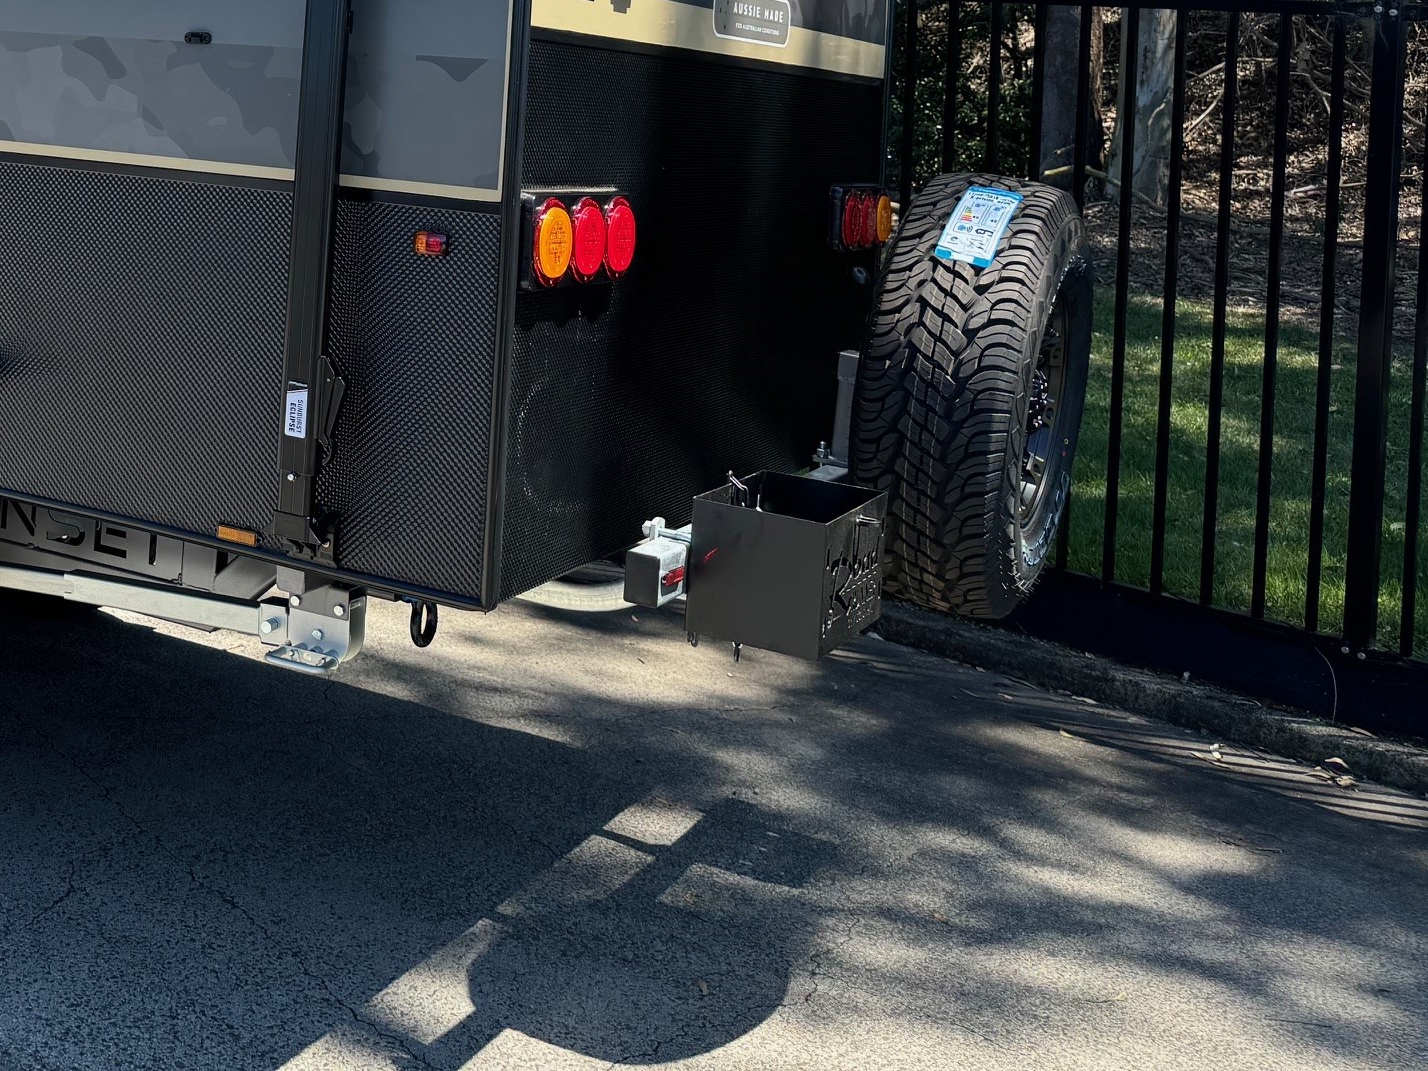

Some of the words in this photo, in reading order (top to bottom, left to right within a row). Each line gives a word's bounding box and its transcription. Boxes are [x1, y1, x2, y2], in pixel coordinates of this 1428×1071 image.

[733, 2, 761, 18] AUSSIE
[764, 8, 784, 23] MADE
[288, 402, 297, 433] ECLIPSE
